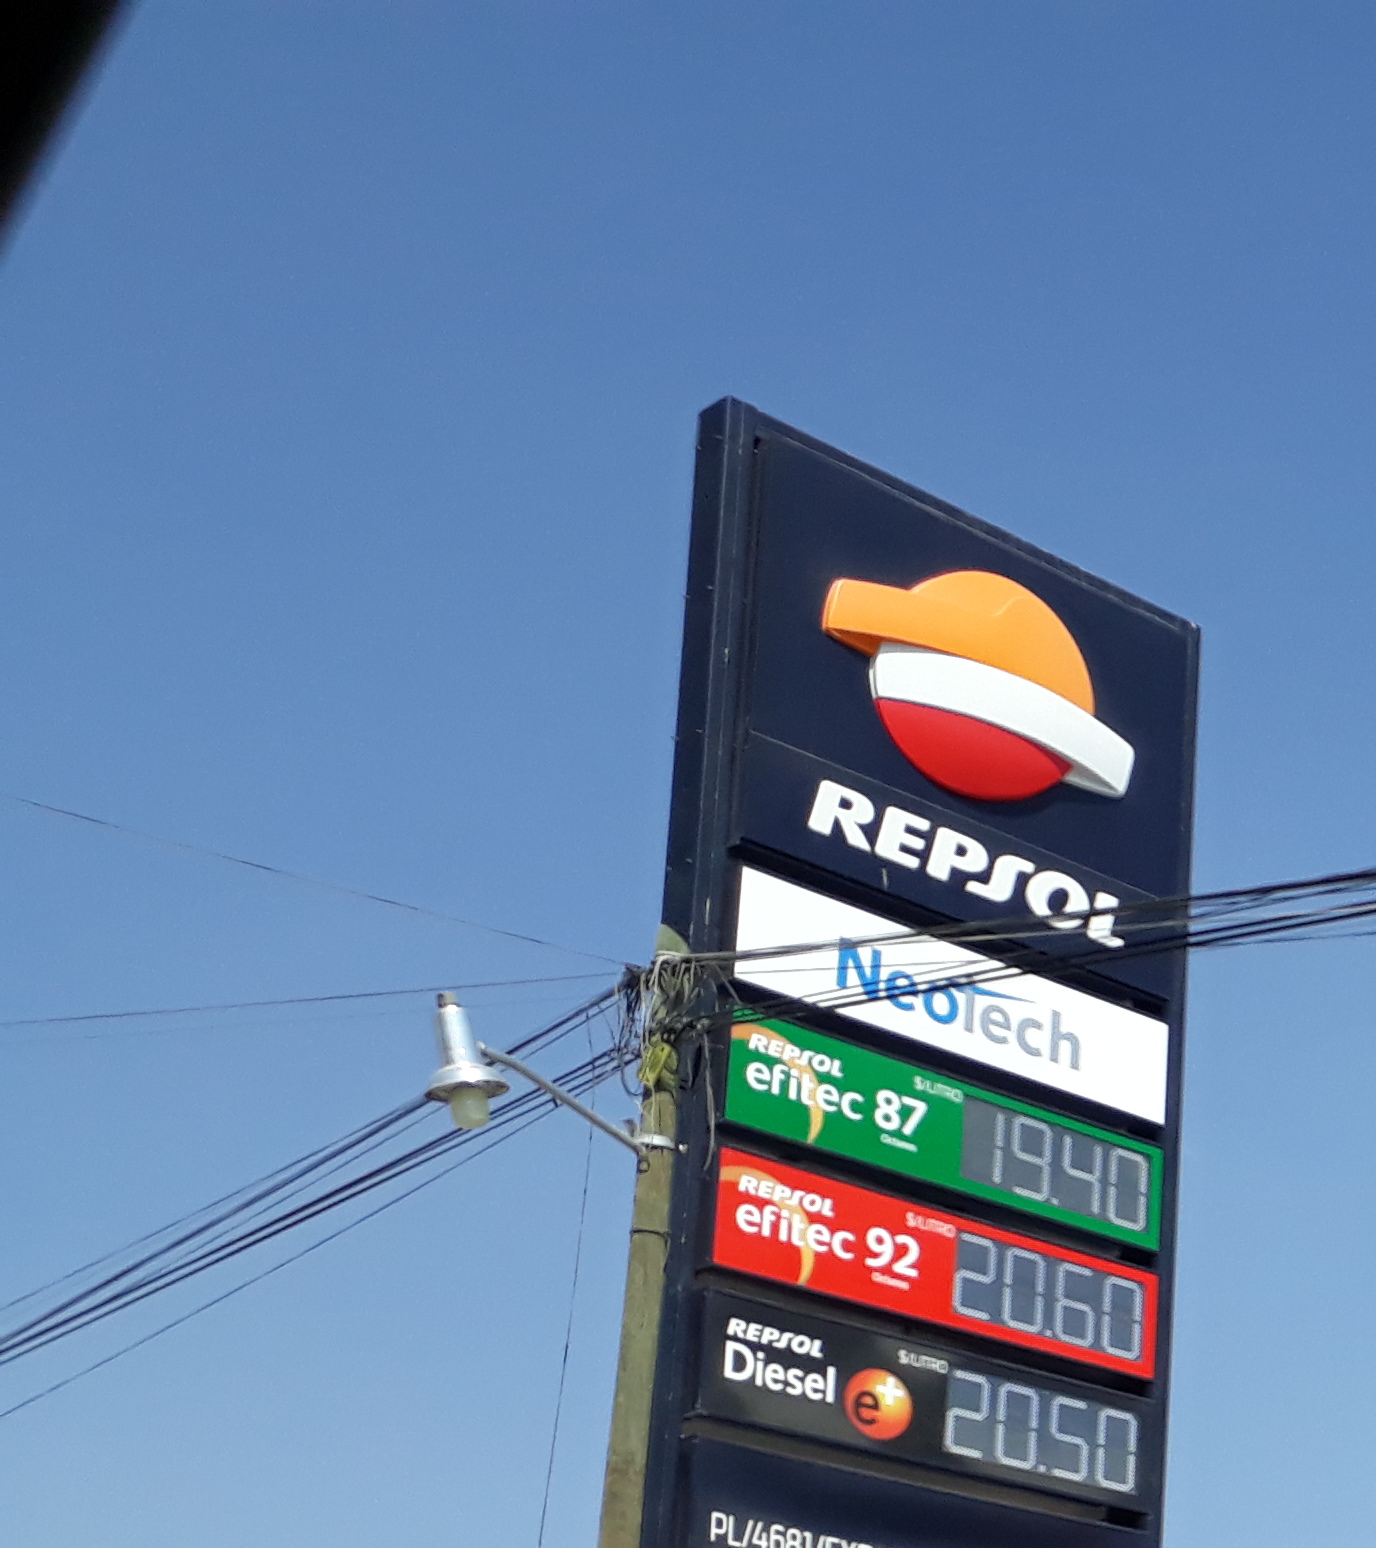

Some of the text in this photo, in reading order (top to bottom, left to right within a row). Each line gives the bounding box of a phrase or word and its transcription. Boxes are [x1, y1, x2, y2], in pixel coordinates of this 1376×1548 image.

[808, 779, 1125, 948] REPSOL
[836, 936, 1081, 1071] NeoTech
[748, 1033, 844, 1078] REPSOL
[746, 1061, 928, 1137] efitec 87
[738, 1174, 834, 1217] REPSOL
[992, 1112, 1148, 1231] 19.40
[735, 1203, 921, 1278] efitec 92
[952, 1232, 1143, 1360] 20.60
[723, 1340, 837, 1404] Diesel
[726, 1317, 824, 1358] REPSOL
[944, 1369, 1138, 1492] 20.50
